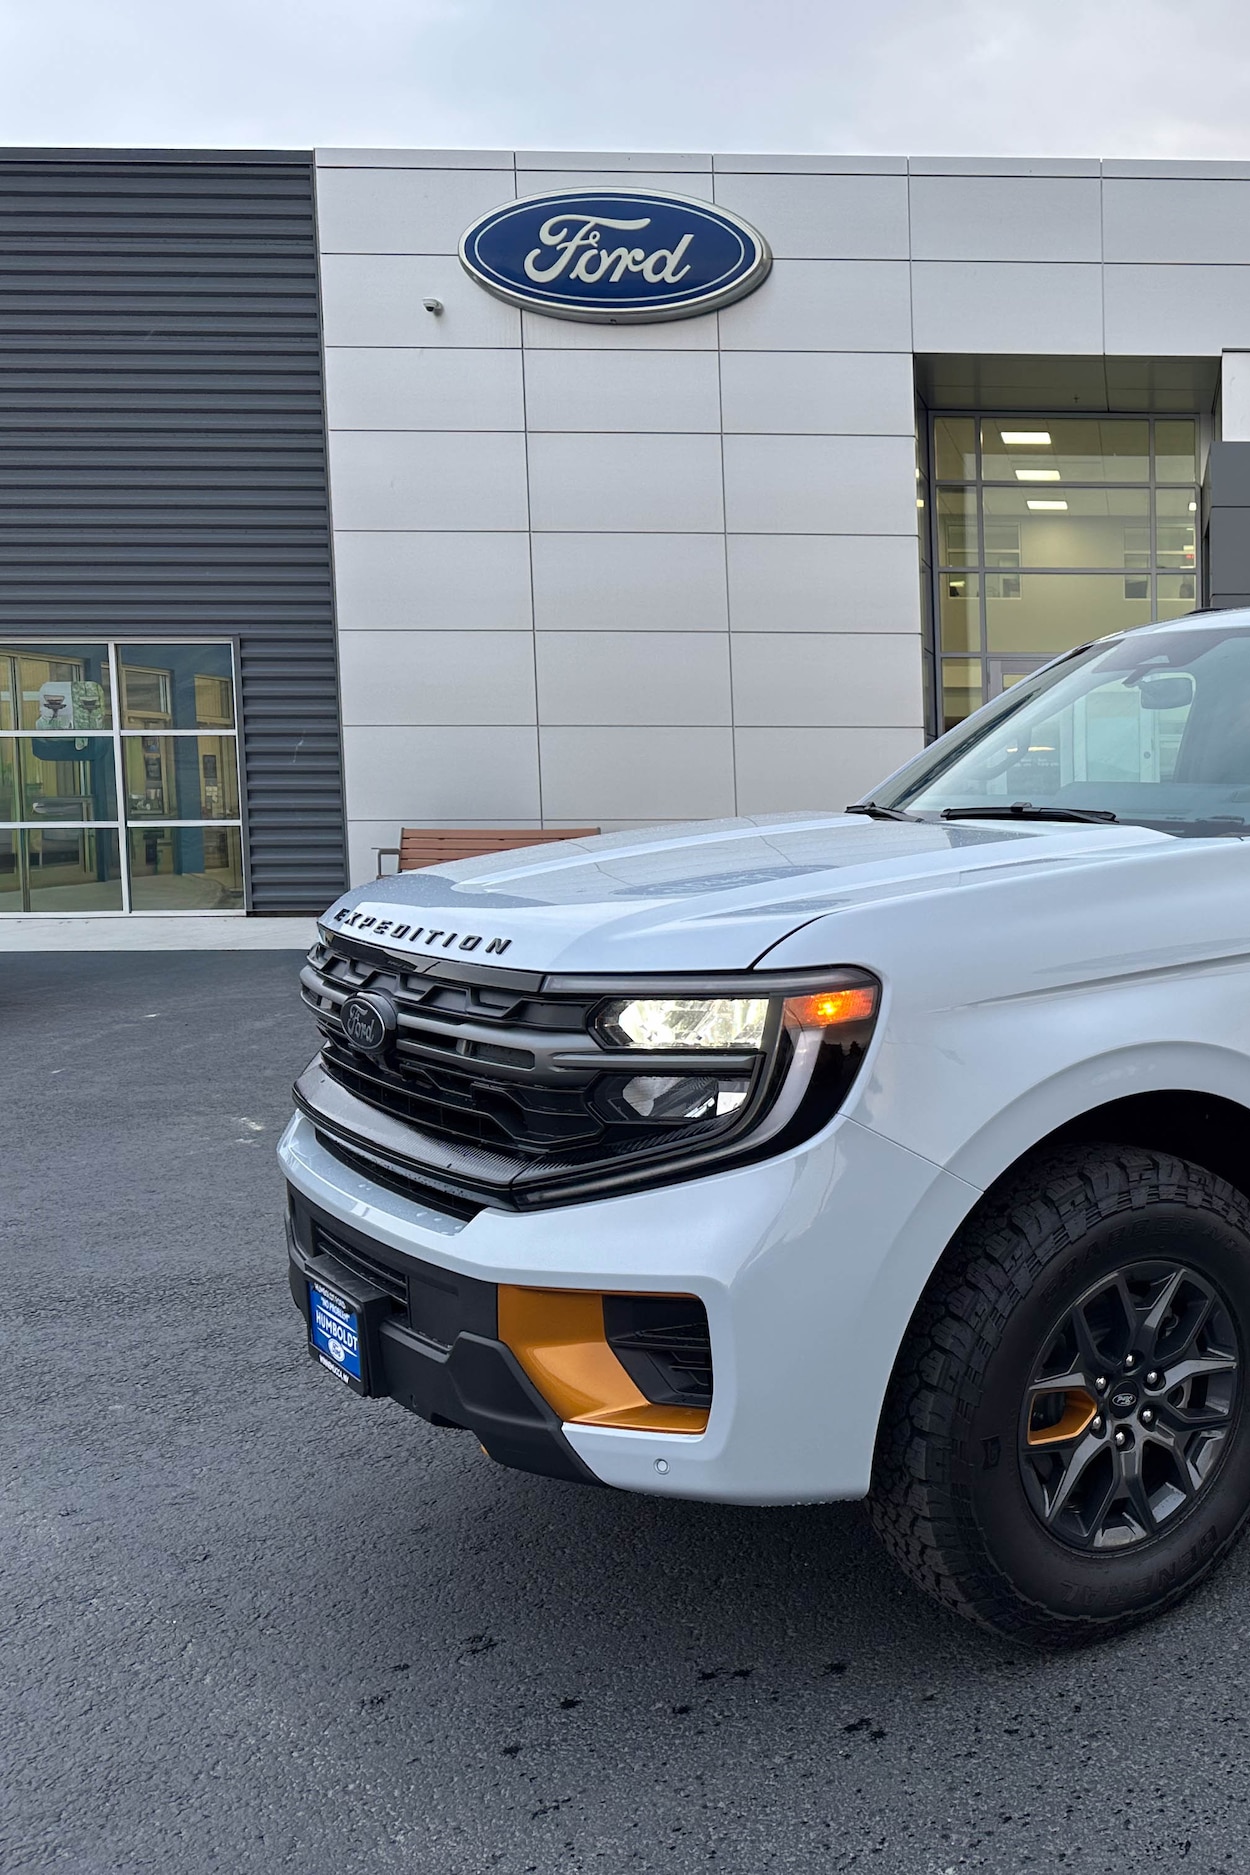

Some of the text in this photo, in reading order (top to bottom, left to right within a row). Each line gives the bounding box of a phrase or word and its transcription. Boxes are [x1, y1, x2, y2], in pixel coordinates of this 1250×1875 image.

[523, 214, 694, 285] Ford
[334, 908, 513, 955] EXPEDITION
[347, 1003, 375, 1043] Ford
[316, 1309, 358, 1351] HUMBOLDT
